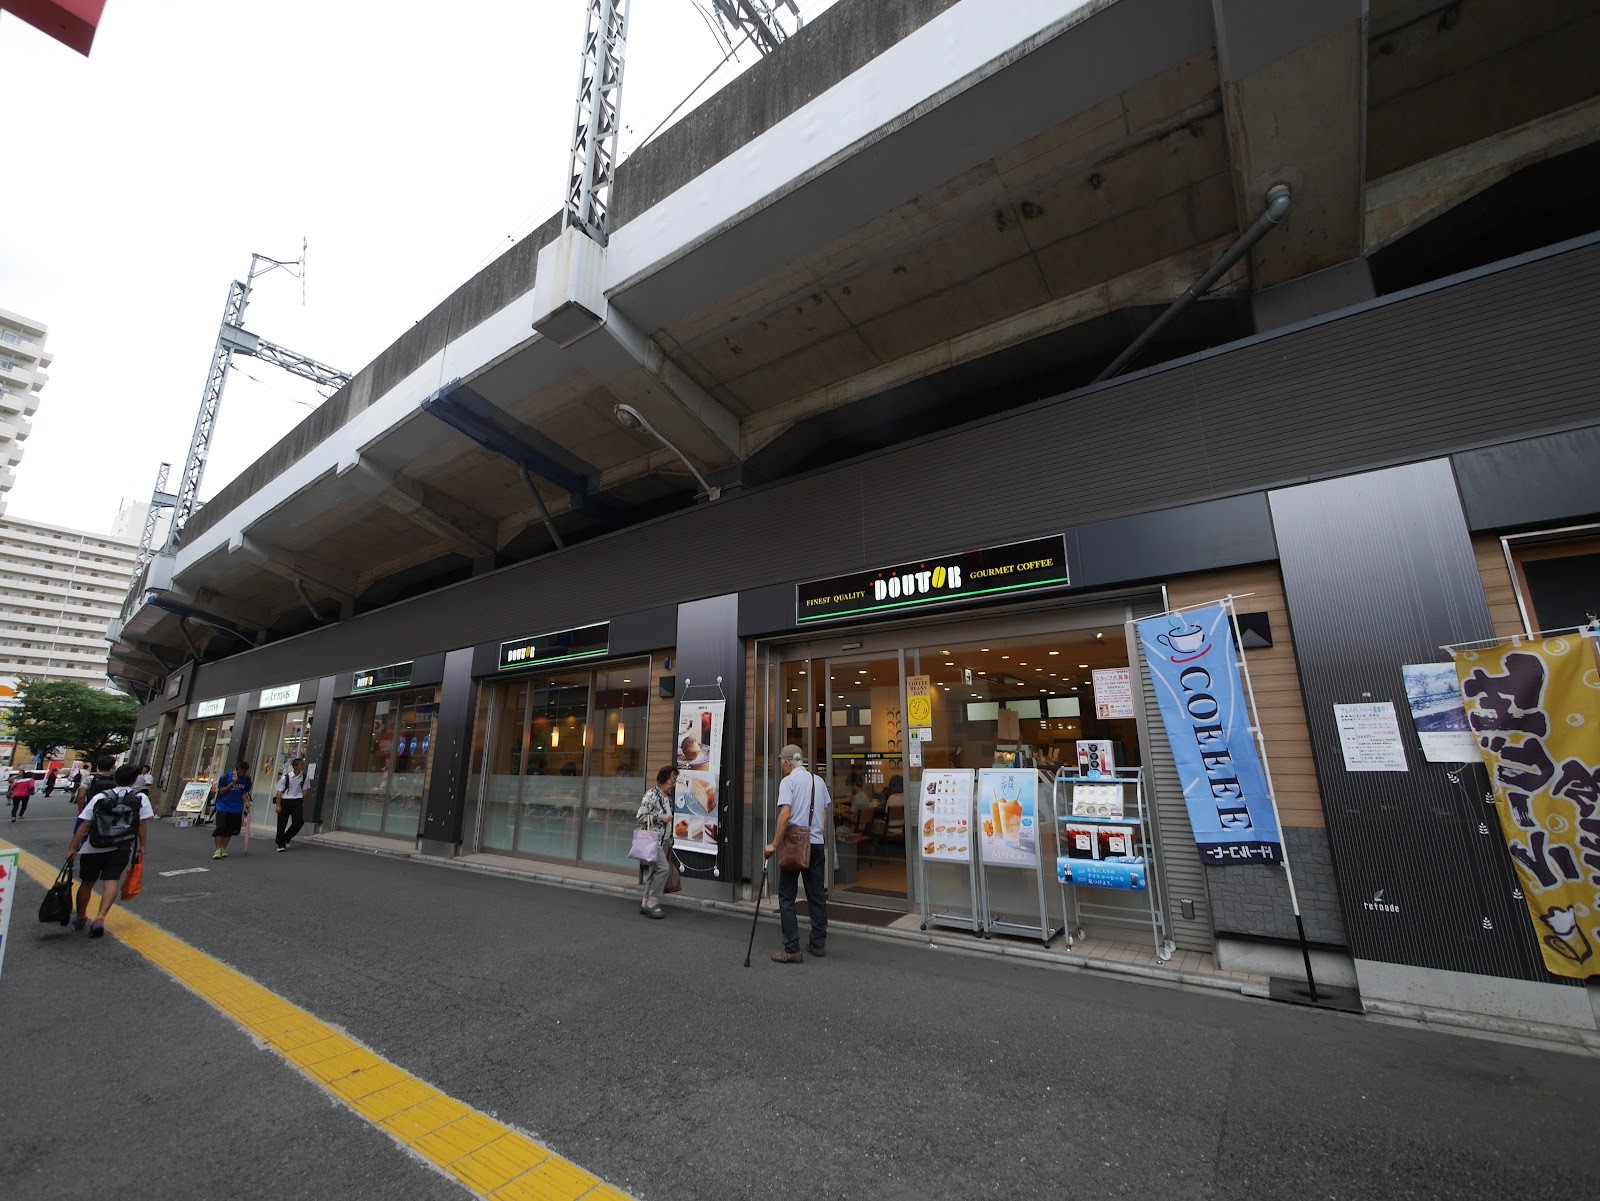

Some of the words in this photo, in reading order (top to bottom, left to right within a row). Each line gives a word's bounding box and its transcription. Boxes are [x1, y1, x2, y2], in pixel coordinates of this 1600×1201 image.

[970, 565, 1015, 580] GOURMET
[1016, 558, 1054, 572] COFFEE
[874, 565, 962, 601] DOUTOR
[806, 597, 831, 607] FINEST
[833, 590, 866, 603] QUALITY
